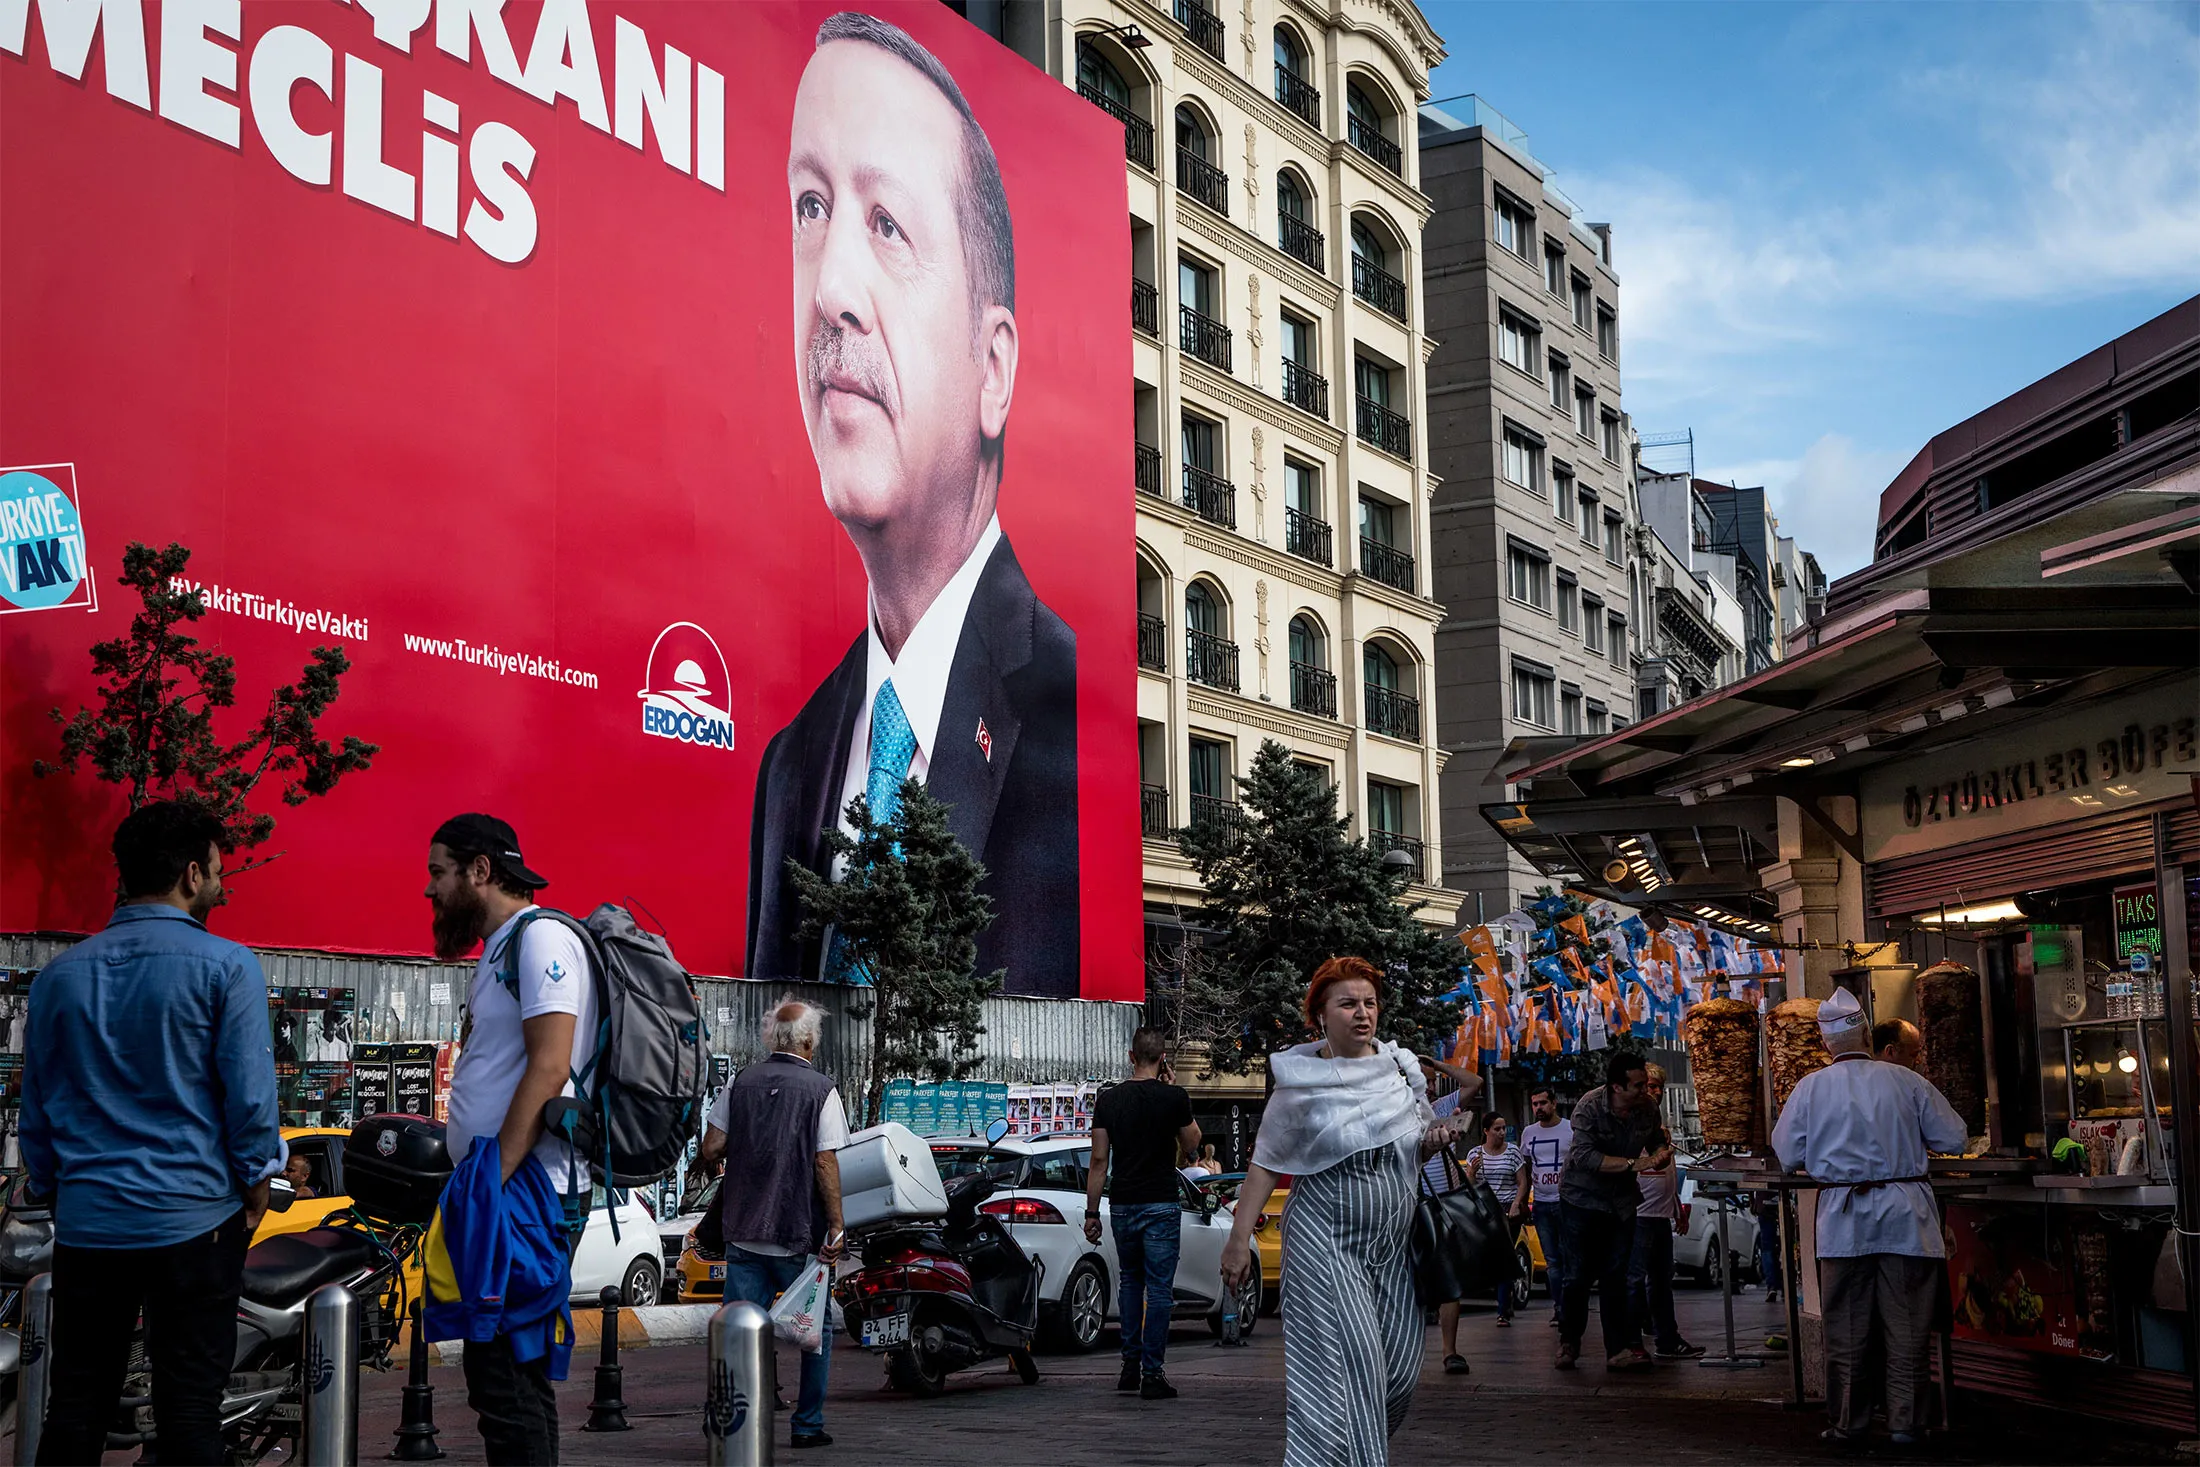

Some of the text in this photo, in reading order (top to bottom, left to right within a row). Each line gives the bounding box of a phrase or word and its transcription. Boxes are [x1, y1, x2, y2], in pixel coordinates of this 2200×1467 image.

[403, 633, 599, 690] www.TurkiyeVakti.com
[1903, 718, 2196, 828] ÖZTÜRKLER BÜFE
[889, 1089, 911, 1097] PARKFEST
[913, 1089, 935, 1097] PARKFEST
[1541, 1172, 1561, 1185] CRO
[714, 1266, 724, 1278] 34
[865, 1315, 906, 1334] 34 FF
[878, 1330, 901, 1345] 844
[2052, 1333, 2075, 1348] Döner
